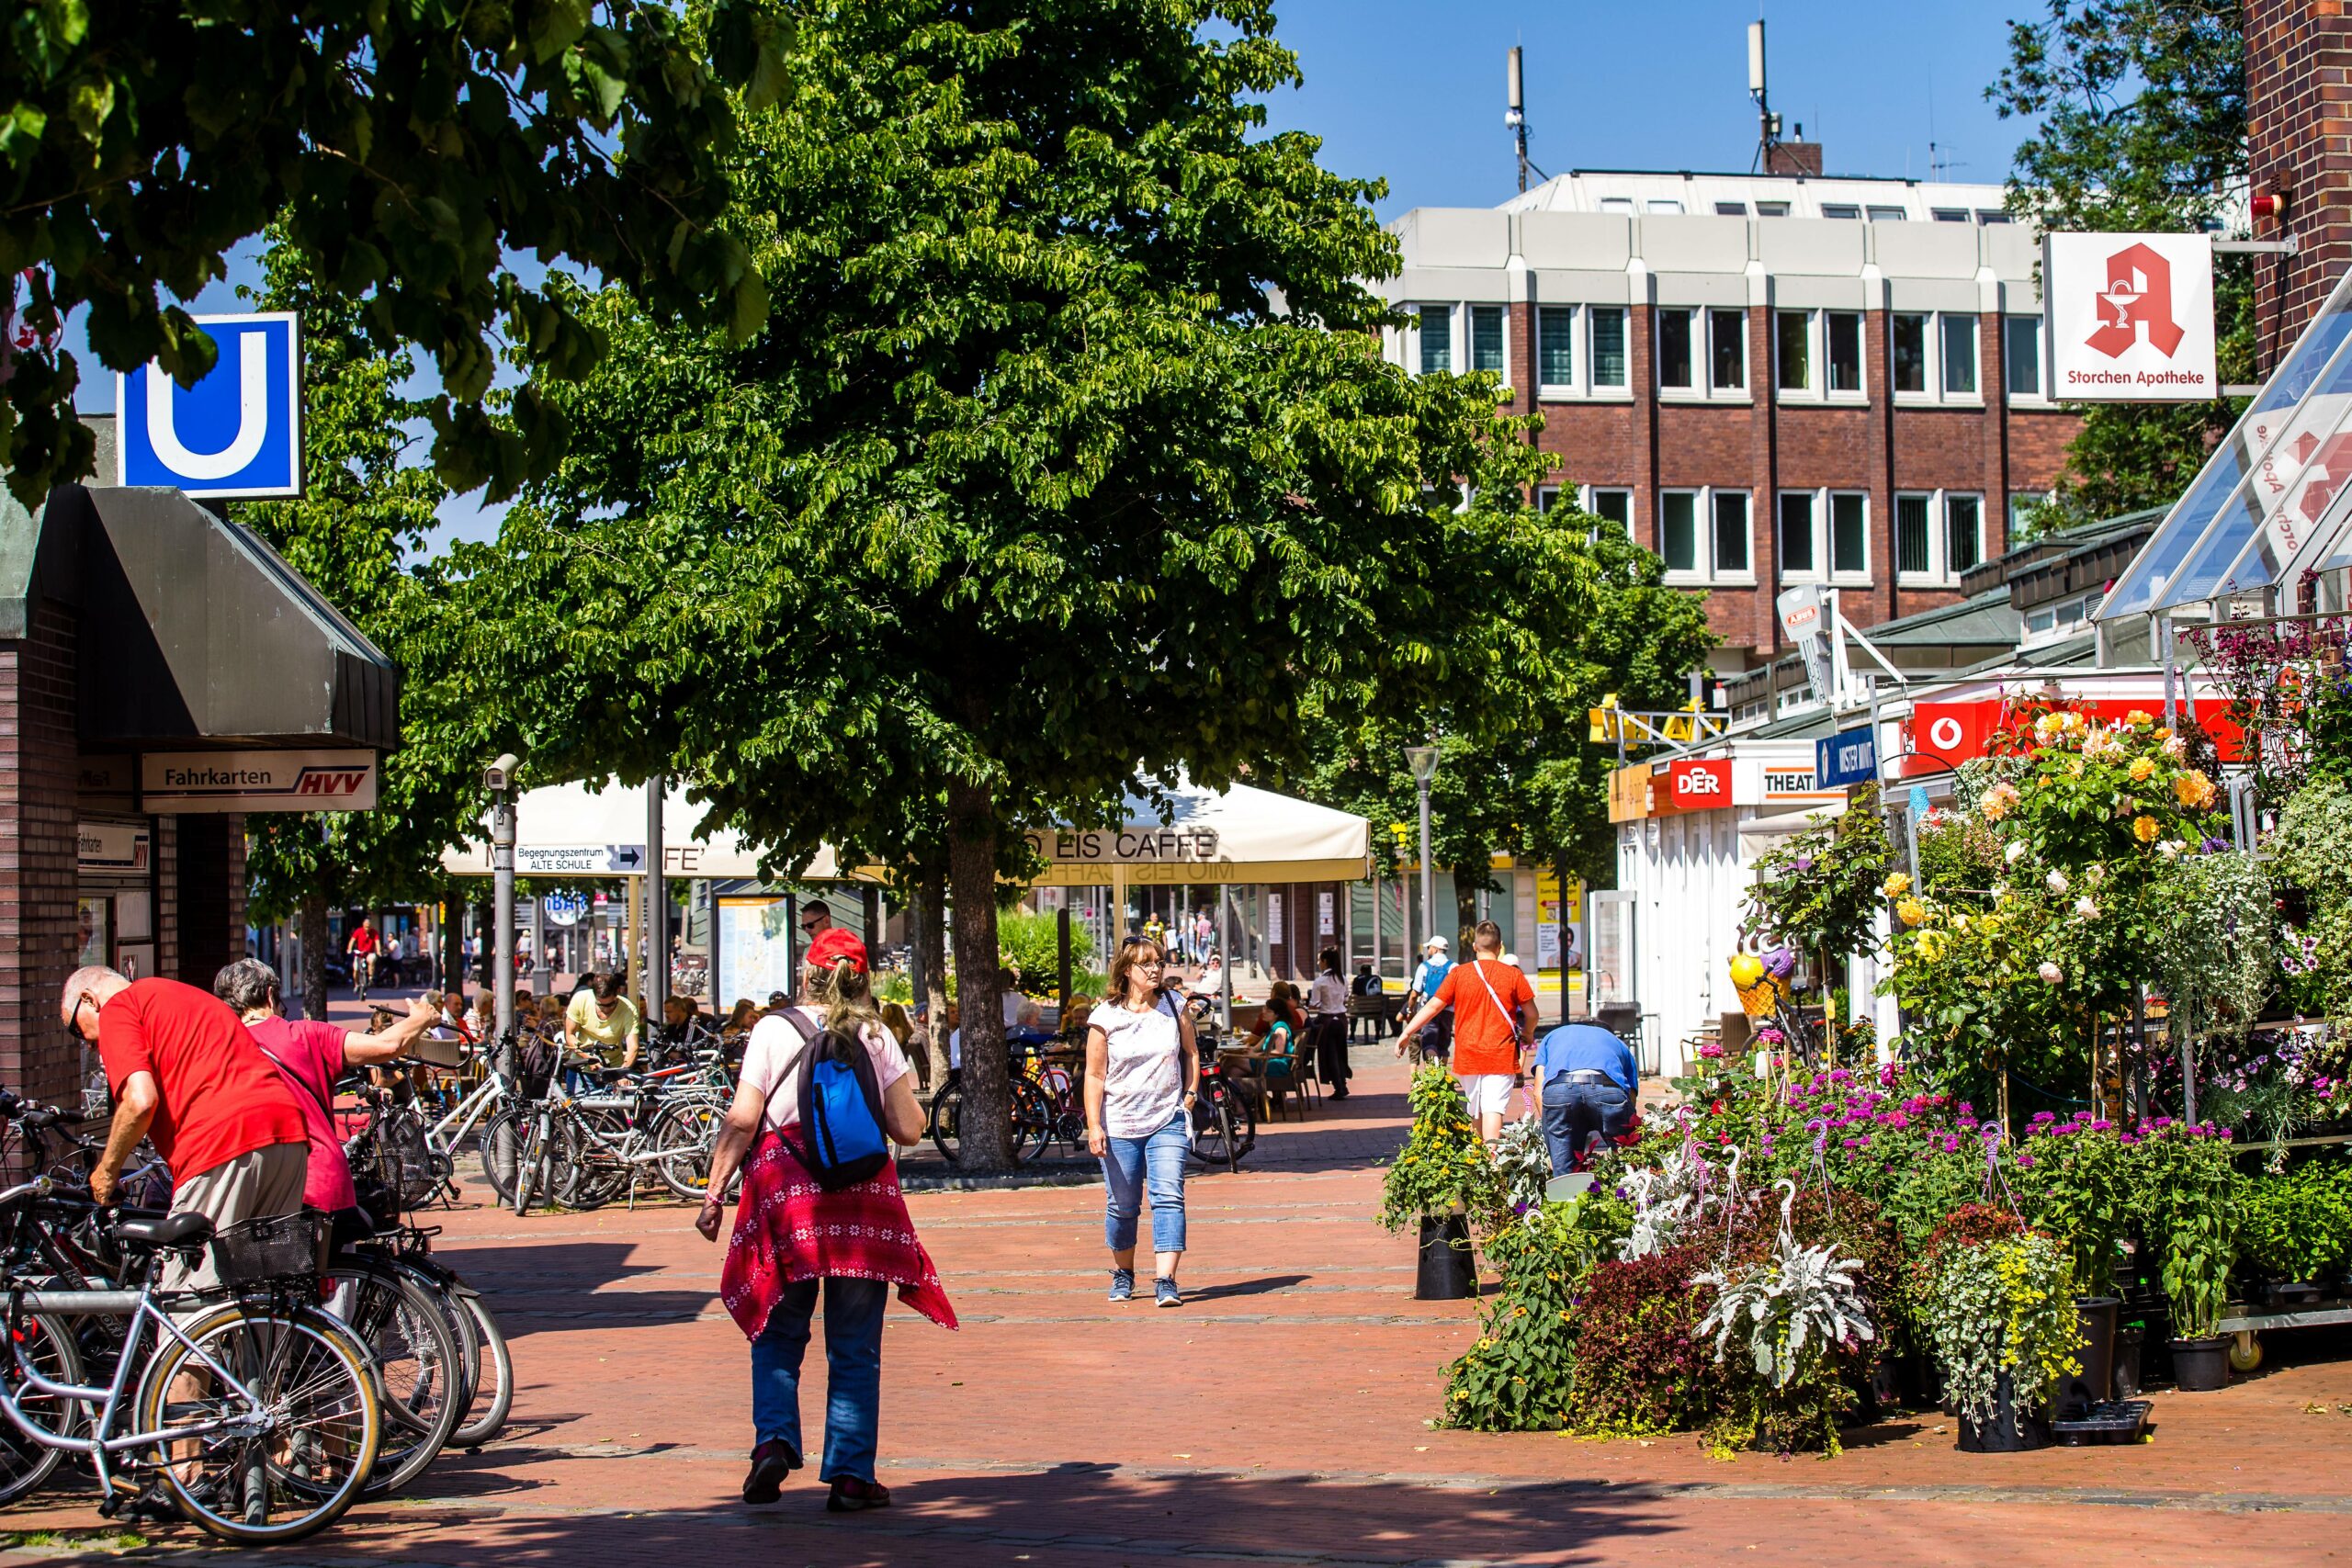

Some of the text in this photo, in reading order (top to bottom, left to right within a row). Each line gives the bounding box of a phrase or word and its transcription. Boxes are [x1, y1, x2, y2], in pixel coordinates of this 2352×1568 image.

[2068, 370, 2204, 387] Storchen Apotheke
[147, 332, 267, 479] U
[1791, 608, 1815, 625] ABUS
[1839, 744, 1858, 773] MISTER
[165, 768, 366, 794] Fahrkarten HVV
[1678, 774, 1720, 794] DER
[1765, 774, 1815, 791] THEAT
[518, 849, 604, 860] Begegnungszentrum
[1057, 834, 1101, 858] EIS
[530, 860, 592, 870] ALTE SCHULE
